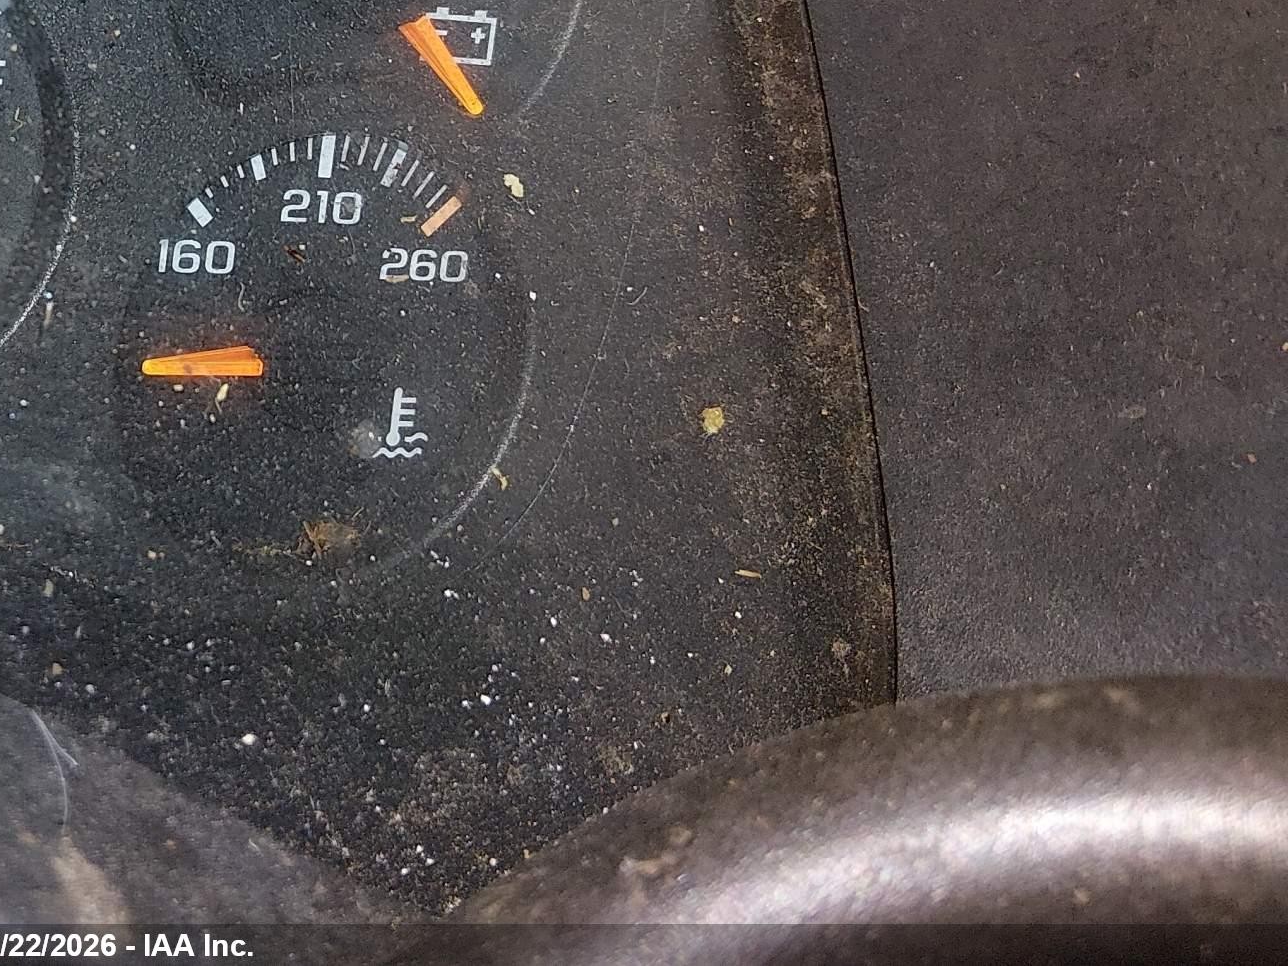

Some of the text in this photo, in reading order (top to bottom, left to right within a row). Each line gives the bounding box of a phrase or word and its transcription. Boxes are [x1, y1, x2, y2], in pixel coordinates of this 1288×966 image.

[280, 189, 362, 225] 210
[157, 239, 236, 275] 160
[379, 247, 469, 283] 260
